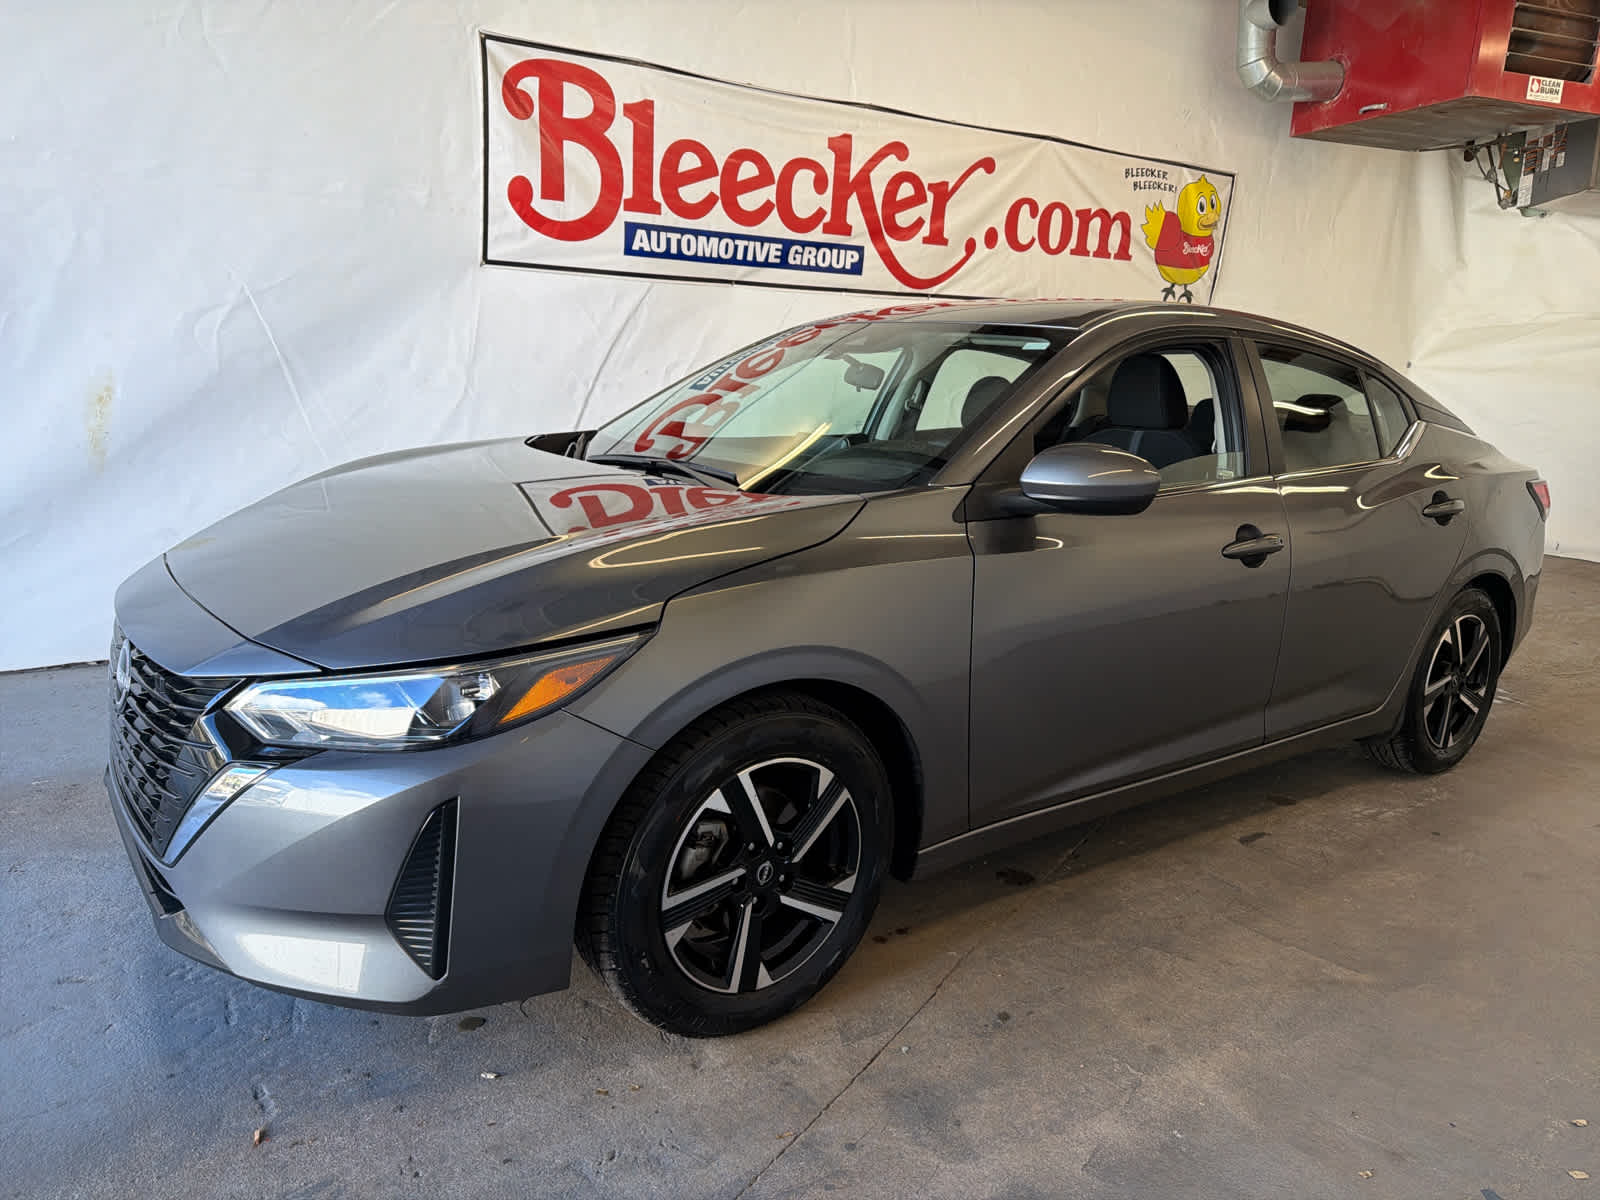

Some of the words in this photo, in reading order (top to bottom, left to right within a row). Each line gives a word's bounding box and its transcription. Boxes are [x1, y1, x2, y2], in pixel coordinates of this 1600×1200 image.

[1541, 79, 1561, 88] CLEAN
[1540, 87, 1560, 96] BURN
[1124, 168, 1168, 180] BLEECKER
[632, 229, 781, 264] AUTOMOTIVE
[787, 245, 860, 270] GROUP
